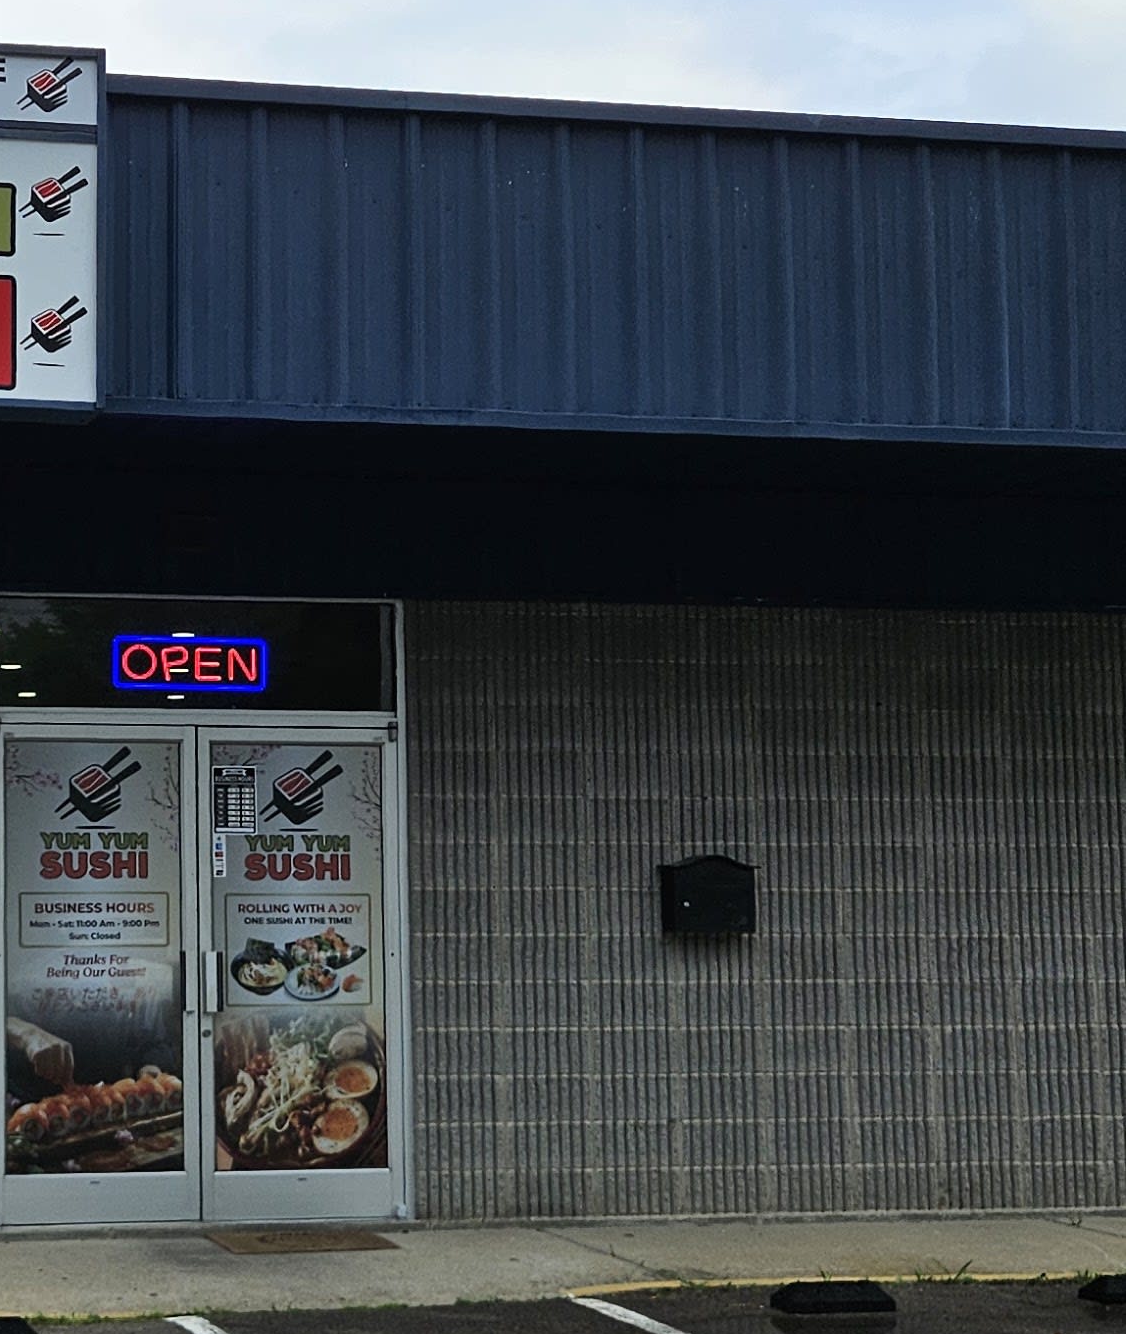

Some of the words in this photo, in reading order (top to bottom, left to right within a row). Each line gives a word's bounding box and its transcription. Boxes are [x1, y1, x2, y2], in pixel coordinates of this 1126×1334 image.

[121, 643, 258, 682] OPEN
[40, 832, 91, 850] YUM
[98, 832, 149, 850] YUM
[245, 835, 294, 852] YUM
[301, 835, 351, 852] YUM
[39, 851, 149, 880] SUSHI
[244, 853, 351, 881] SUSHI
[34, 902, 103, 914] BUSINESS
[106, 902, 155, 914] HOURS
[238, 903, 290, 914] ROLLING
[293, 903, 325, 914] WITH
[328, 903, 337, 914] A
[339, 903, 362, 914] JOY
[76, 920, 97, 928] 11:00
[99, 920, 115, 928] Am
[122, 919, 142, 928] 9:00
[144, 919, 160, 928] Pm
[91, 931, 121, 940] Closed
[64, 954, 106, 965] Thanks
[109, 954, 129, 965] For
[47, 967, 80, 979] Being
[83, 967, 105, 977] Our
